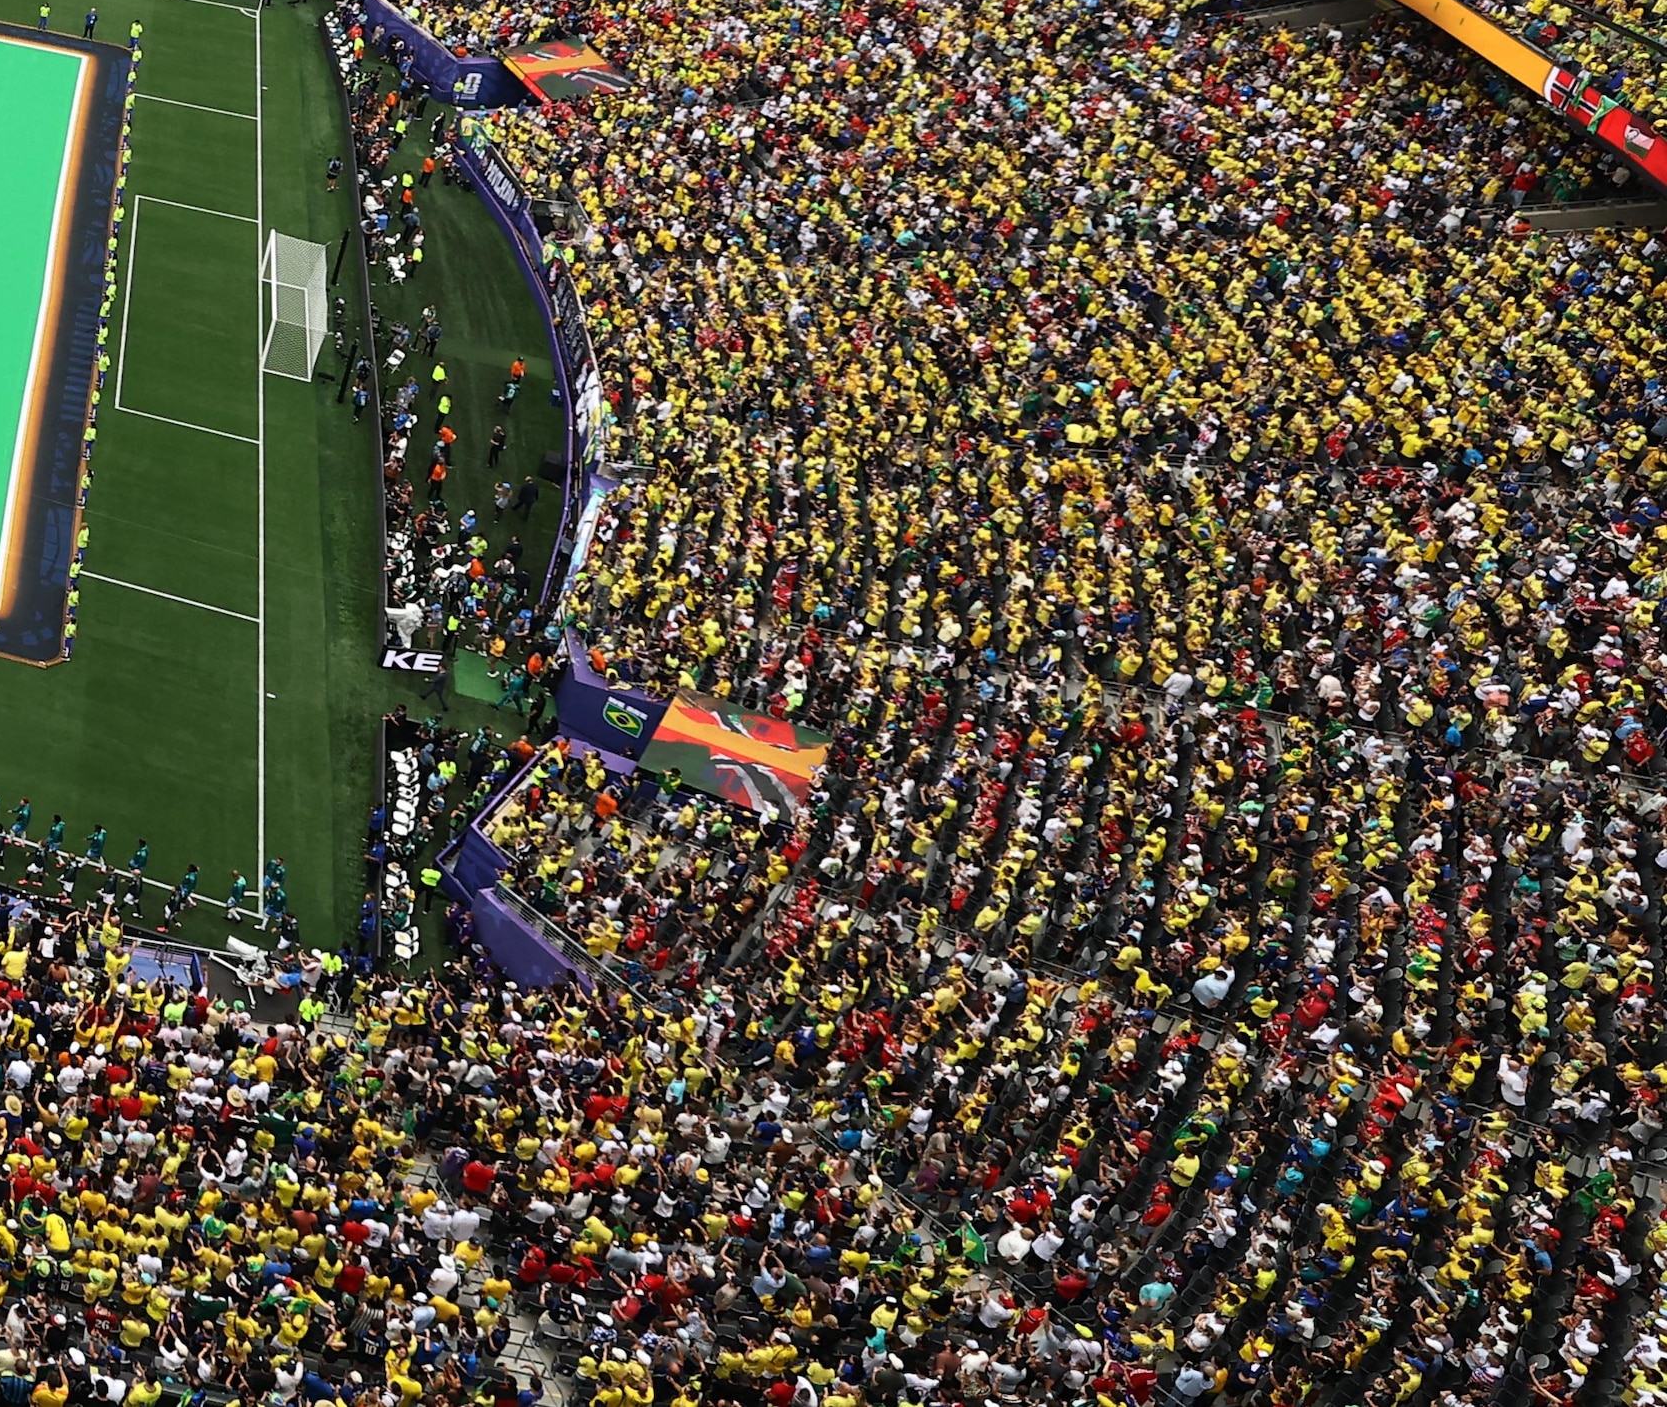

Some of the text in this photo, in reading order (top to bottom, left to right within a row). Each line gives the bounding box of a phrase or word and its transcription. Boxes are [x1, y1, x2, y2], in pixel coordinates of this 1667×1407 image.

[382, 650, 444, 672] KE
[95, 1319, 110, 1330] 26
[365, 1343, 377, 1355] 10
